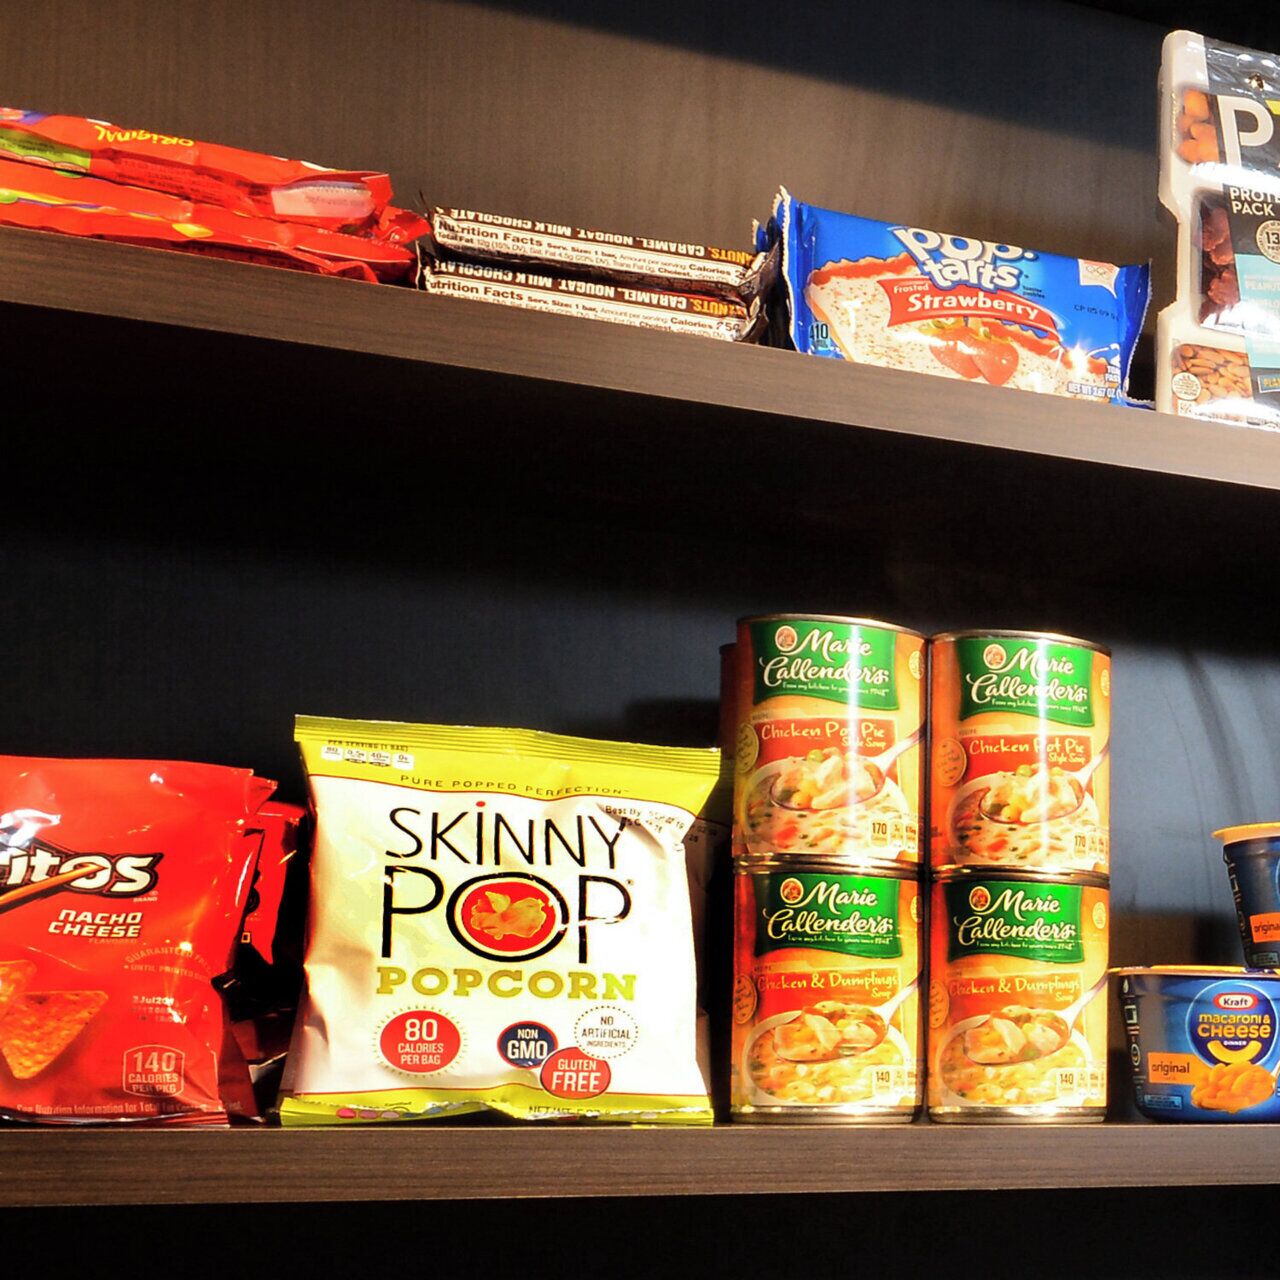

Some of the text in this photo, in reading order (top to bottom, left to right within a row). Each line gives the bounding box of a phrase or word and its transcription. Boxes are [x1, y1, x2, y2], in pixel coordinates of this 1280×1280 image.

[1232, 200, 1275, 217] PACK
[504, 233, 733, 276] Facts Calories
[483, 287, 524, 301] Facts
[907, 292, 1039, 320] Strawberry
[788, 629, 873, 661] Marie
[761, 722, 821, 740] Chicken
[969, 739, 1029, 755] Chicken
[452, 779, 517, 791] POPPED
[787, 884, 878, 914] Marie
[980, 888, 1060, 920] Marie
[58, 908, 143, 924] NACHO
[380, 866, 631, 964] POP
[763, 908, 893, 939] Callender's
[48, 921, 142, 938] CHEESE
[954, 915, 1076, 946] Callender's
[376, 967, 637, 1001] POPCORN
[829, 970, 898, 990] Dumplings
[1014, 976, 1080, 995] Dumplings
[1223, 996, 1249, 1007] Kraft
[600, 1016, 614, 1025] NO
[1199, 1012, 1262, 1024] macaroni
[405, 1019, 438, 1042] 80
[517, 1029, 538, 1039] NON
[582, 1028, 631, 1039] ARTIFICIAL
[398, 1043, 444, 1053] CALORIES
[507, 1041, 548, 1060] GMO
[133, 1051, 177, 1072] 140
[401, 1055, 441, 1065] PER BAG
[557, 1058, 597, 1071] GLUTEN
[128, 1072, 178, 1084] CALORIES
[551, 1072, 601, 1093] FREE
[155, 1083, 177, 1094] PKG
